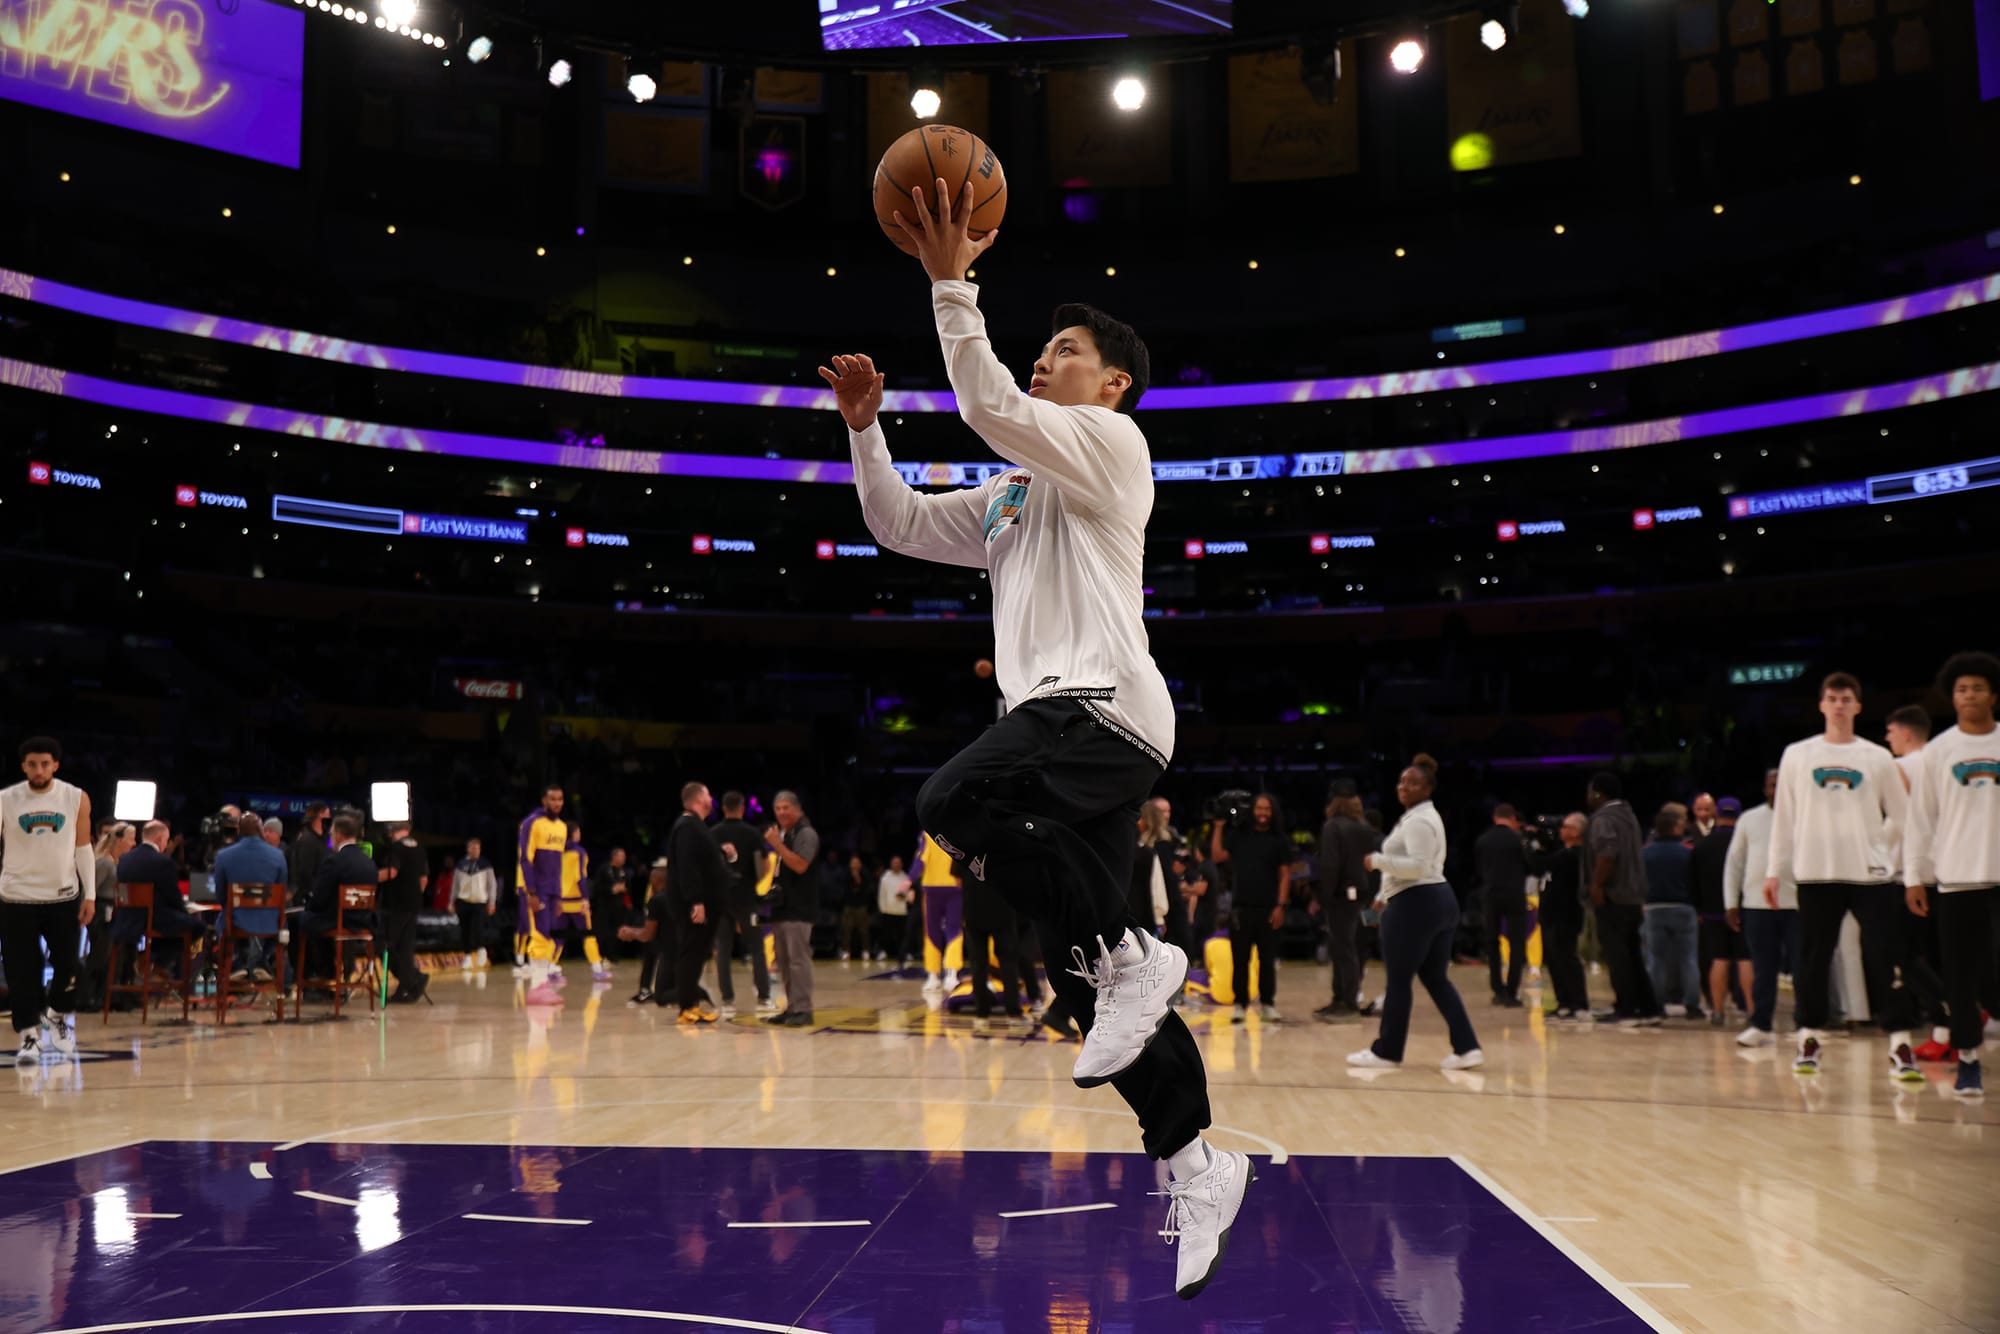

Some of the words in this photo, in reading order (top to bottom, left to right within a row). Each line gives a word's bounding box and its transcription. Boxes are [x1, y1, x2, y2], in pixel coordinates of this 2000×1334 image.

[1157, 466, 1207, 477] Grizzlies
[1229, 461, 1244, 478] 0
[52, 469, 102, 490] TOYOTA
[1912, 467, 1970, 495] 6:53
[200, 491, 249, 510] TOYOTA
[1822, 487, 1867, 505] BANK
[1655, 506, 1703, 523] TOYOTA
[420, 518, 452, 536] EAST
[450, 520, 487, 538] WEST
[487, 523, 527, 542] BANK
[1518, 520, 1566, 535] TOYOTA
[585, 533, 630, 547] TOYOTA
[712, 538, 756, 552] TOYOTA
[1204, 541, 1249, 554] TOYOTA
[1329, 535, 1376, 549] TOYOTA
[835, 543, 879, 557] TOYOTA
